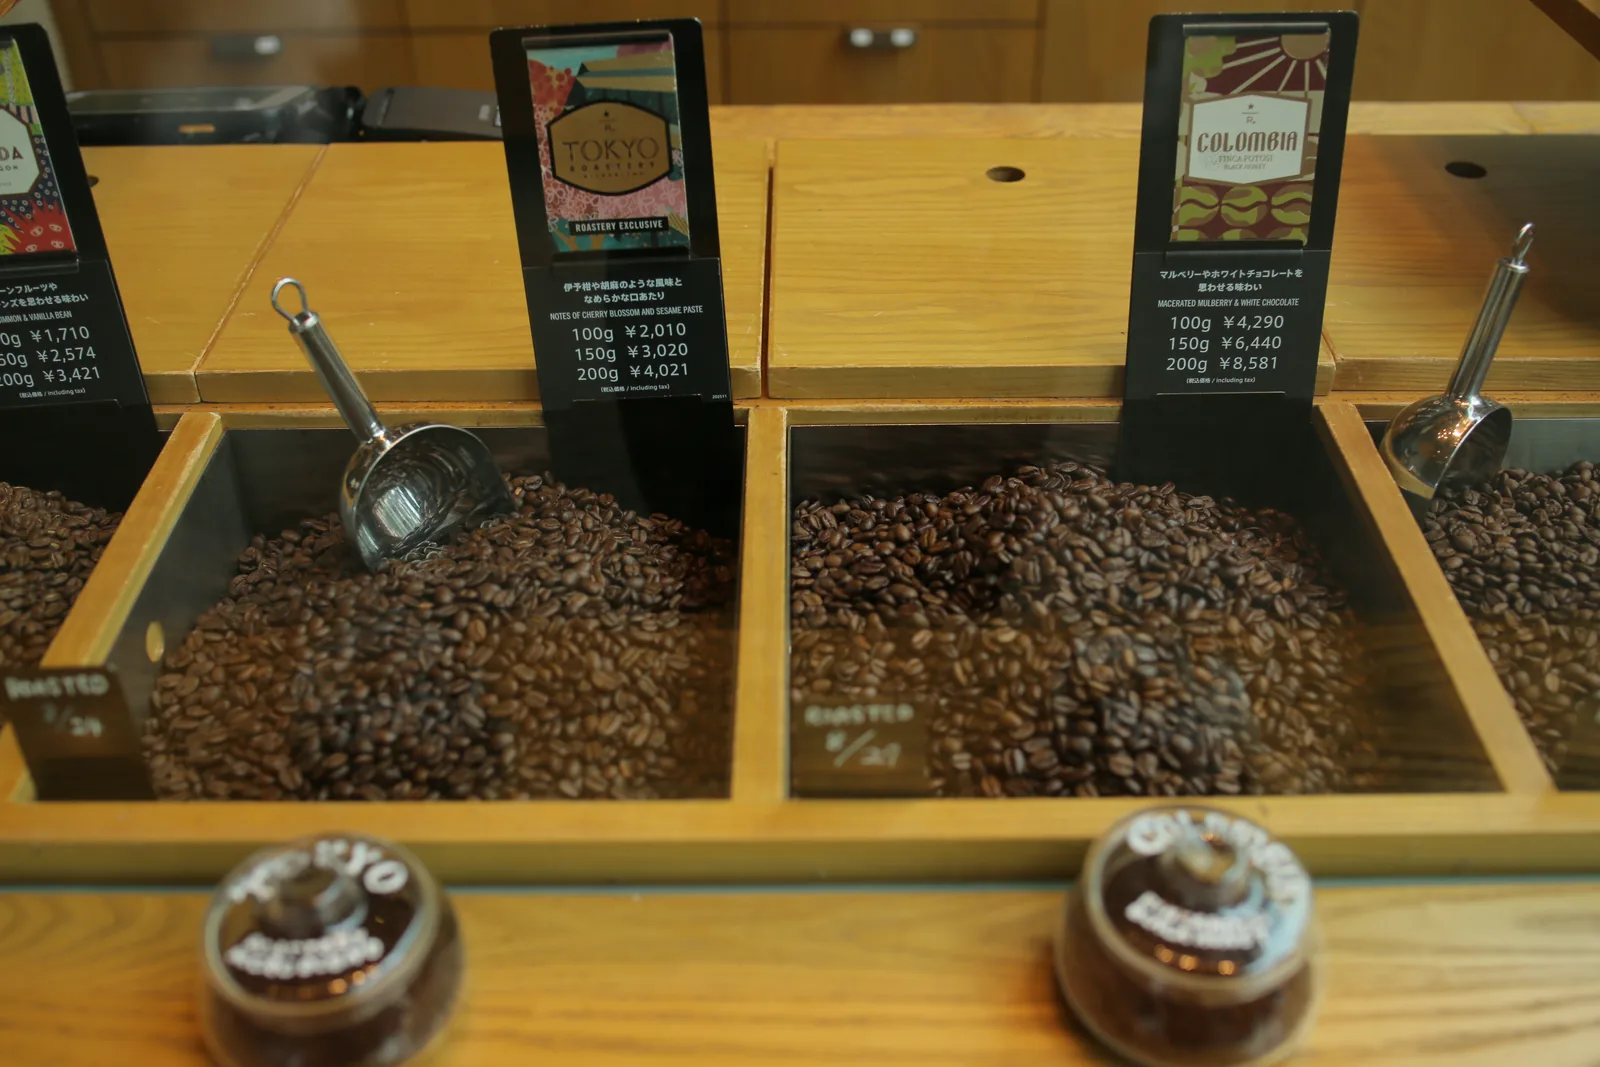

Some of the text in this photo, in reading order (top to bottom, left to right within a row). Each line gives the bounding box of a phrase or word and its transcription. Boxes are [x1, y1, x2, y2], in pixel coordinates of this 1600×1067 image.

[562, 137, 659, 162] TOKYO
[1197, 131, 1298, 152] COLOMBIA
[575, 219, 663, 233] ROASTERY EXCLUSIVE
[1159, 269, 1303, 280] マルベリーやホワイトチョコレートを
[1197, 283, 1263, 292] 思わせる味わい
[0, 293, 89, 308] ンズを思わせる味わい
[584, 291, 665, 304] なめらかな口あたり
[1158, 298, 1300, 308] MACERATED MULBERRY & WHITE CHOCOLATE
[23, 313, 28, 322] &
[28, 311, 55, 321] VANILLA
[55, 310, 73, 319] BEAN
[550, 305, 704, 321] NOTES OF CHERRY BLOSSOM AND SESAME PASTE
[571, 322, 686, 342] 100g ¥2,010
[1170, 315, 1284, 332] 100g ¥4,290
[30, 326, 90, 343] ¥1,710
[574, 343, 688, 362] 150g ¥3,020
[1169, 336, 1282, 353] 150g ¥6,440
[36, 346, 96, 363] ¥2,574
[577, 363, 688, 382] 200g ¥4,021
[1166, 356, 1278, 373] 200g ¥8,581
[42, 366, 100, 383] ¥3,421
[630, 384, 657, 392] including
